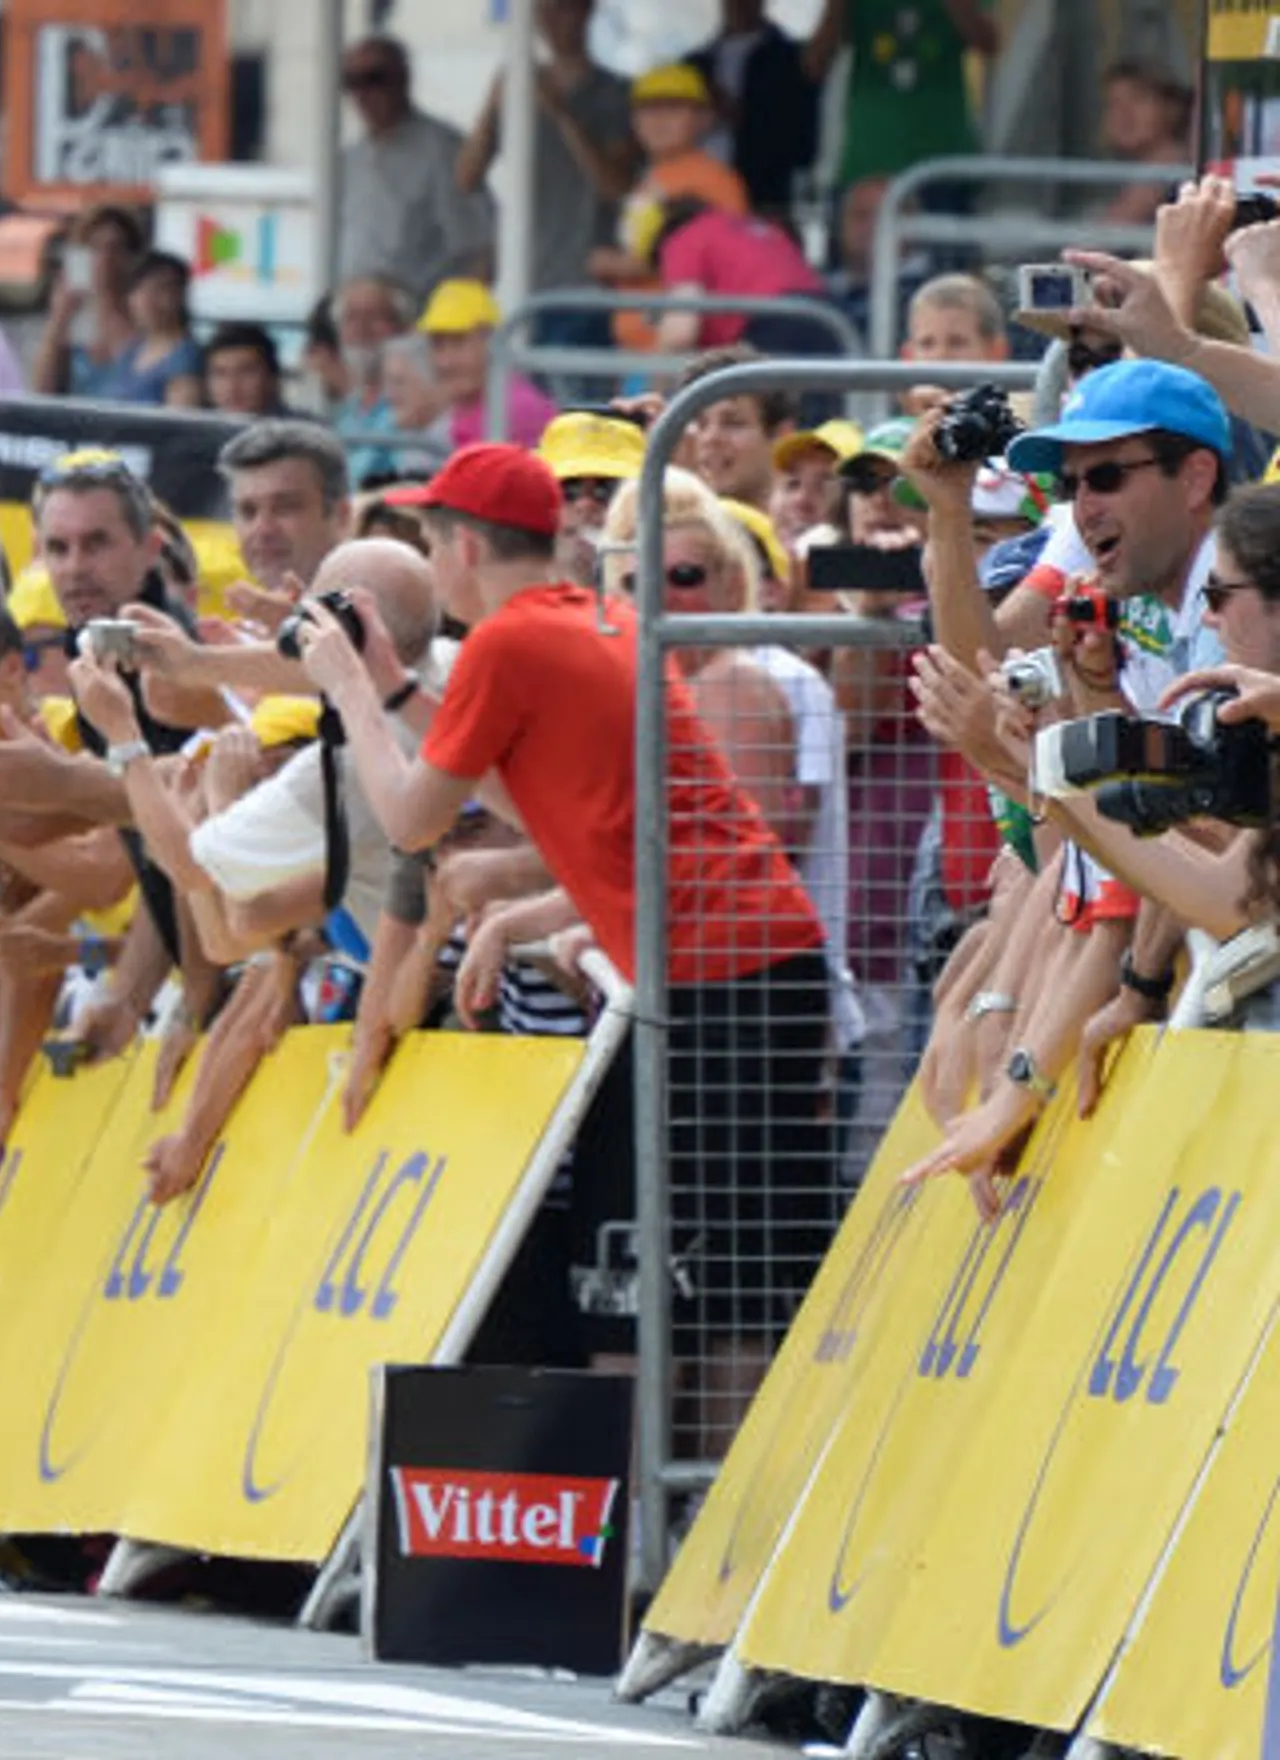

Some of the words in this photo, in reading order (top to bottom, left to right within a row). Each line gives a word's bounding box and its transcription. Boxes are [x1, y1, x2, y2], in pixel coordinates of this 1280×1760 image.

[314, 1147, 447, 1320] LCL
[1088, 1185, 1243, 1405] LCL
[411, 1482, 576, 1549] Vittel
